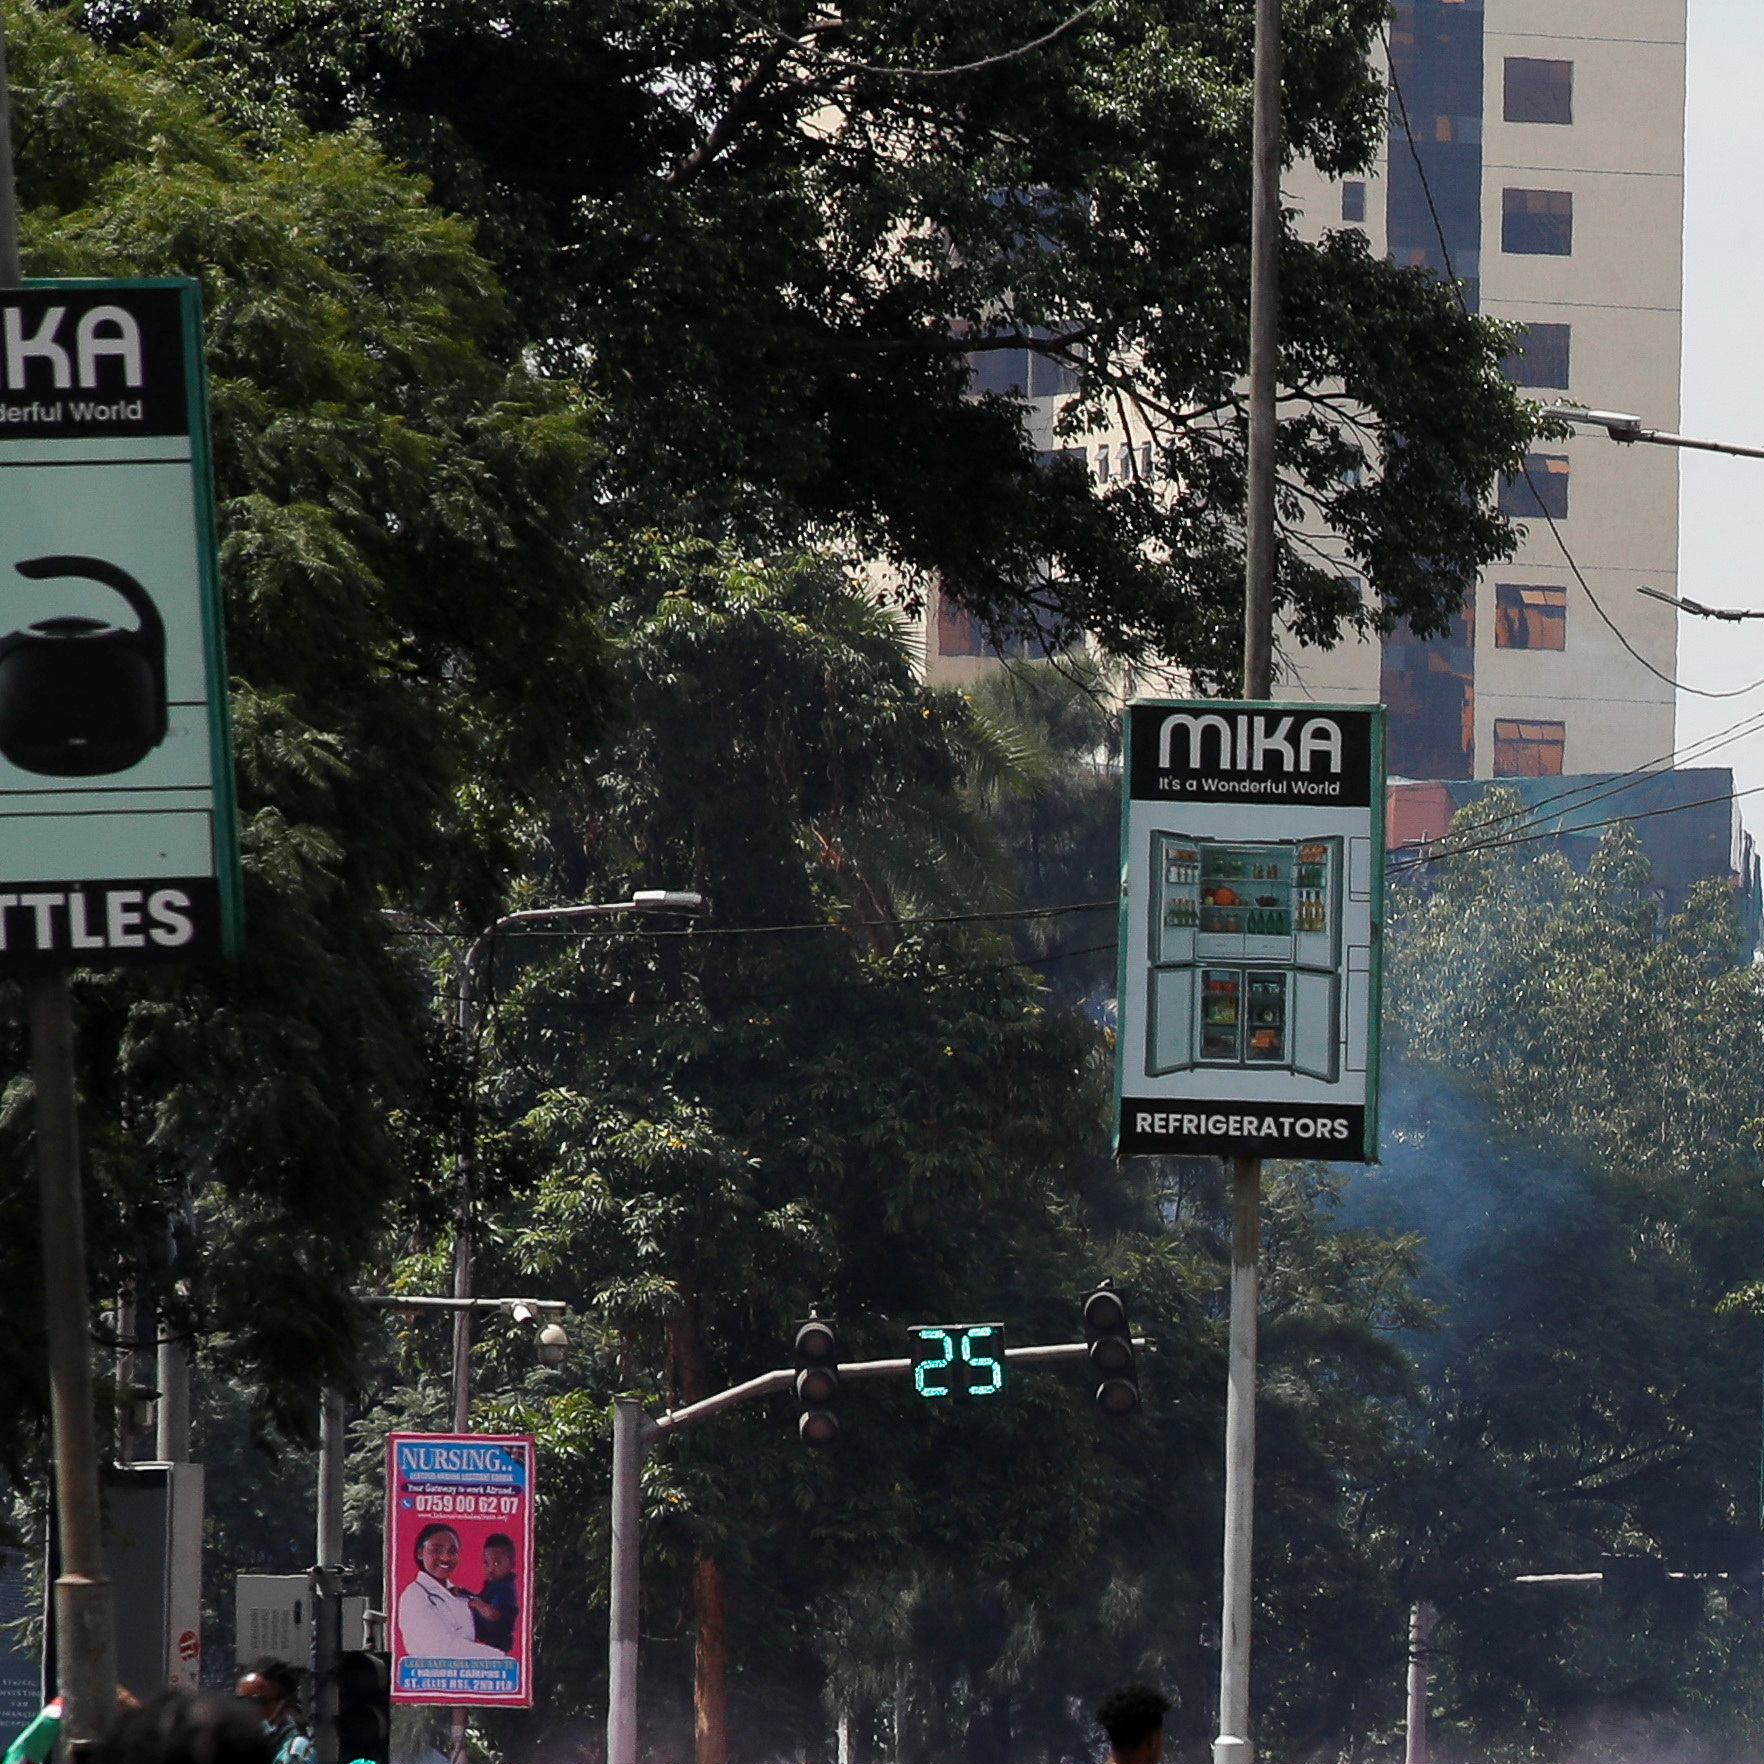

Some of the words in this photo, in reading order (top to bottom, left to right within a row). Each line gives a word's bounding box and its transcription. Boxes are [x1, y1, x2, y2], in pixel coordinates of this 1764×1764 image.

[3, 305, 143, 389] KA
[69, 401, 142, 422] World
[1158, 713, 1342, 773] MIKA
[1159, 776, 1180, 791] It's
[1185, 780, 1197, 791] a
[1201, 777, 1287, 795] Wonderful
[1290, 780, 1340, 796] World
[1136, 1112, 1349, 1139] REFRIGERATORS
[915, 1327, 1002, 1397] 25
[401, 1448, 513, 1471] NURSING..
[416, 1495, 453, 1512] 0759
[456, 1496, 476, 1513] 00
[479, 1497, 498, 1513] 62
[500, 1497, 519, 1514] 07
